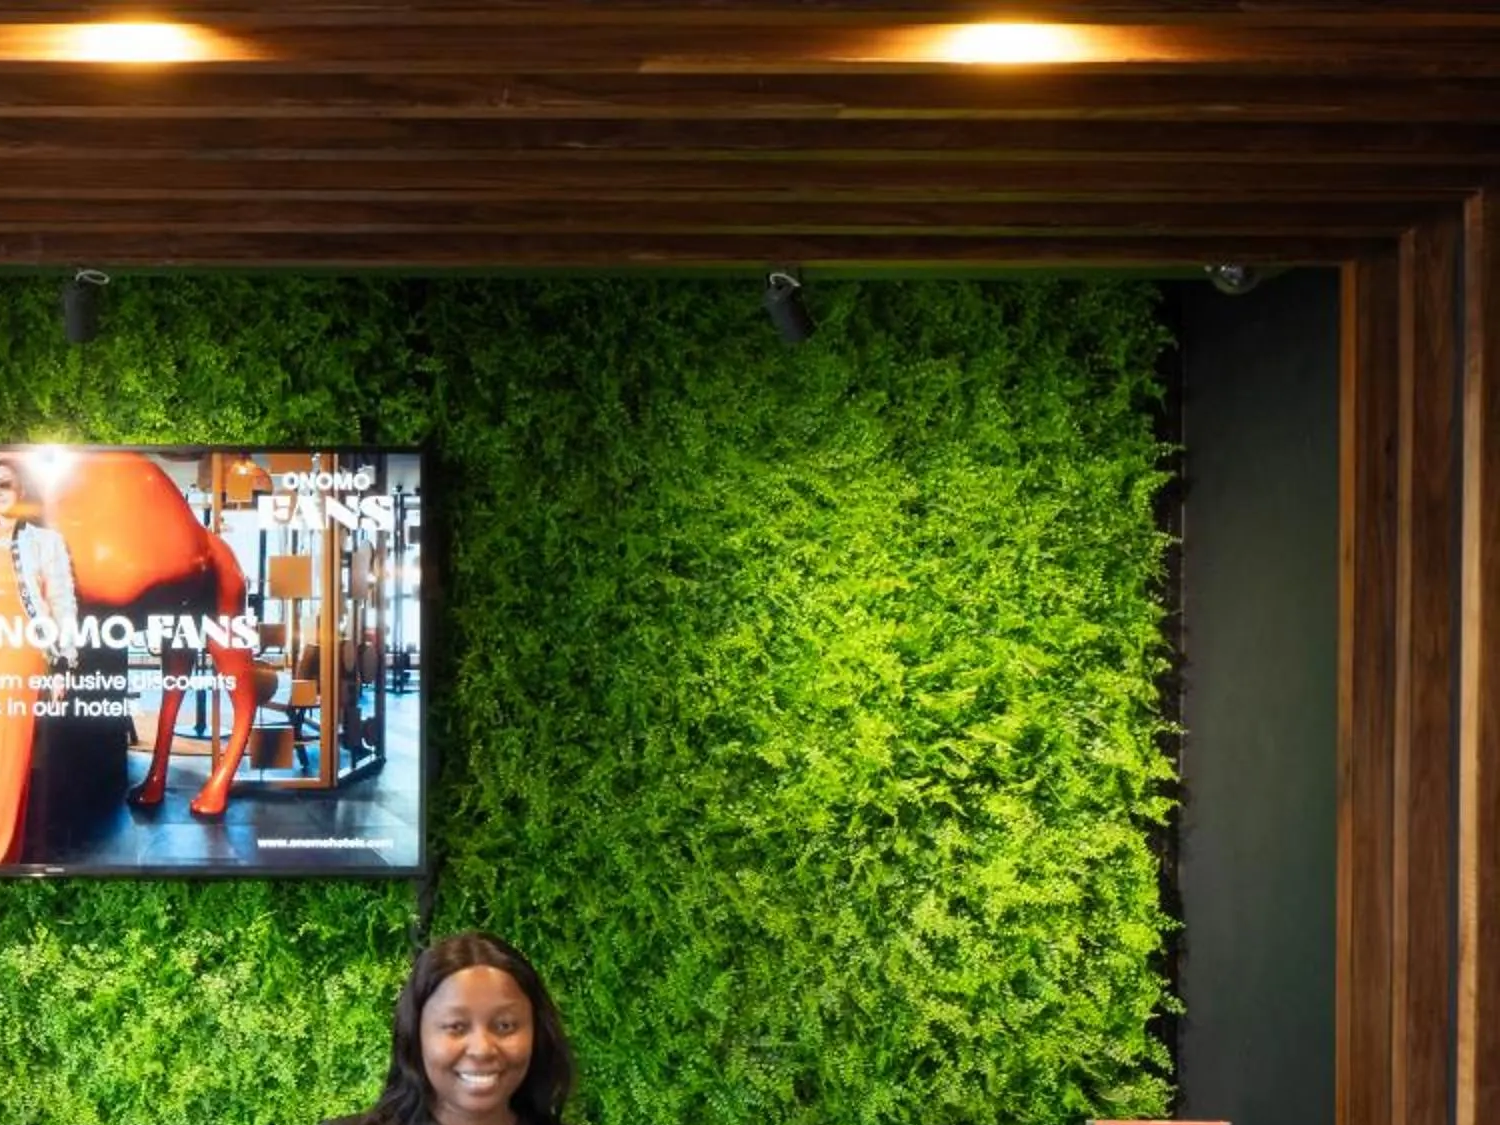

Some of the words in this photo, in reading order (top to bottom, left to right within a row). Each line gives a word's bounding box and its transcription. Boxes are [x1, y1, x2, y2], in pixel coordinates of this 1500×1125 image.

[283, 472, 370, 490] ONOMO
[257, 495, 395, 531] FANS
[147, 614, 258, 649] FANS
[28, 672, 126, 689] exclusive
[7, 698, 26, 715] in
[32, 701, 69, 716] our
